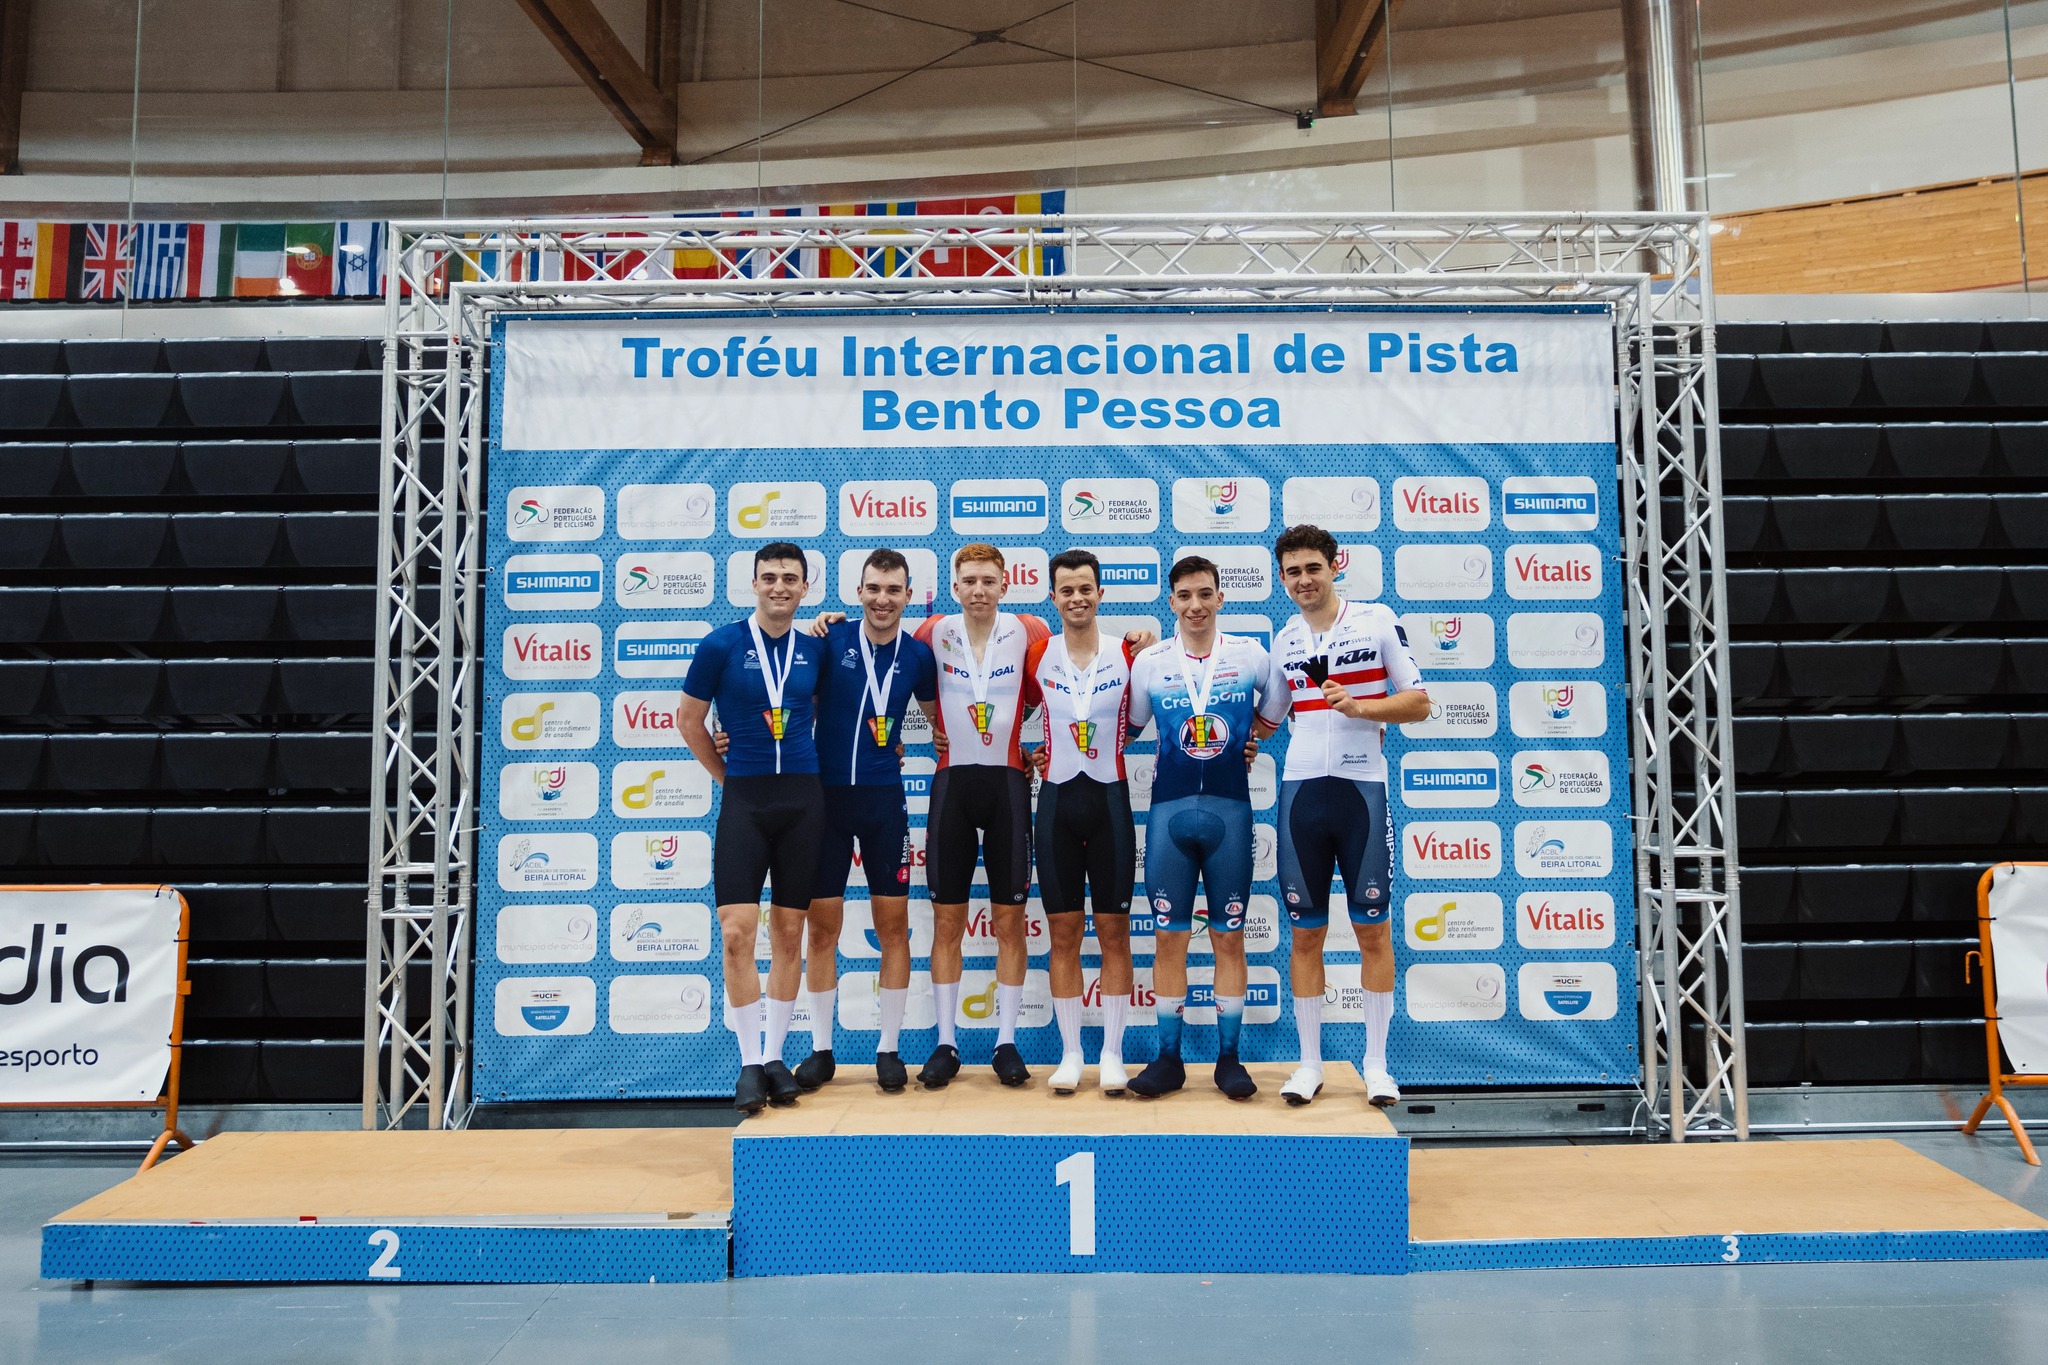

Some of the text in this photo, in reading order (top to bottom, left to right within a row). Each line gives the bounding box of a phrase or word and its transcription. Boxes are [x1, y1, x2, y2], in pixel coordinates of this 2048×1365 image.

[622, 332, 1518, 378] Troféu Internacional de Pista
[862, 388, 1280, 431] Bento Pessoa
[850, 489, 926, 518] Vitalis
[962, 501, 1036, 513] SHIMANO
[1109, 499, 1147, 508] FEDERAÇÃO
[1403, 485, 1479, 514] Vitalis
[1514, 498, 1586, 509] SHIMANO
[1003, 564, 1038, 585] alis
[1102, 569, 1148, 580] MANO
[1221, 567, 1259, 576] FEDERAÇÃO
[1515, 554, 1592, 581] Vitalis
[516, 576, 591, 588] SHIMANO
[514, 633, 591, 662] Vitalis
[1335, 648, 1377, 666] KTM
[954, 665, 1015, 679] POUGAL
[624, 700, 680, 729] Vita
[1162, 692, 1246, 710] Crebom
[1446, 703, 1484, 711] FEDERAÇÃO
[1118, 694, 1128, 755] PORTUGAL
[1413, 773, 1487, 785] SHIMANO
[1560, 773, 1598, 781] FEDERAÇÃO
[1413, 831, 1491, 860] Vitalis
[966, 908, 1042, 937] Vitis
[1527, 901, 1605, 930] Vitalis
[1082, 977, 1156, 1008] Vilis
[1055, 1150, 1096, 1255] 1
[367, 1229, 402, 1278] 2
[1719, 1233, 1743, 1263] 3
